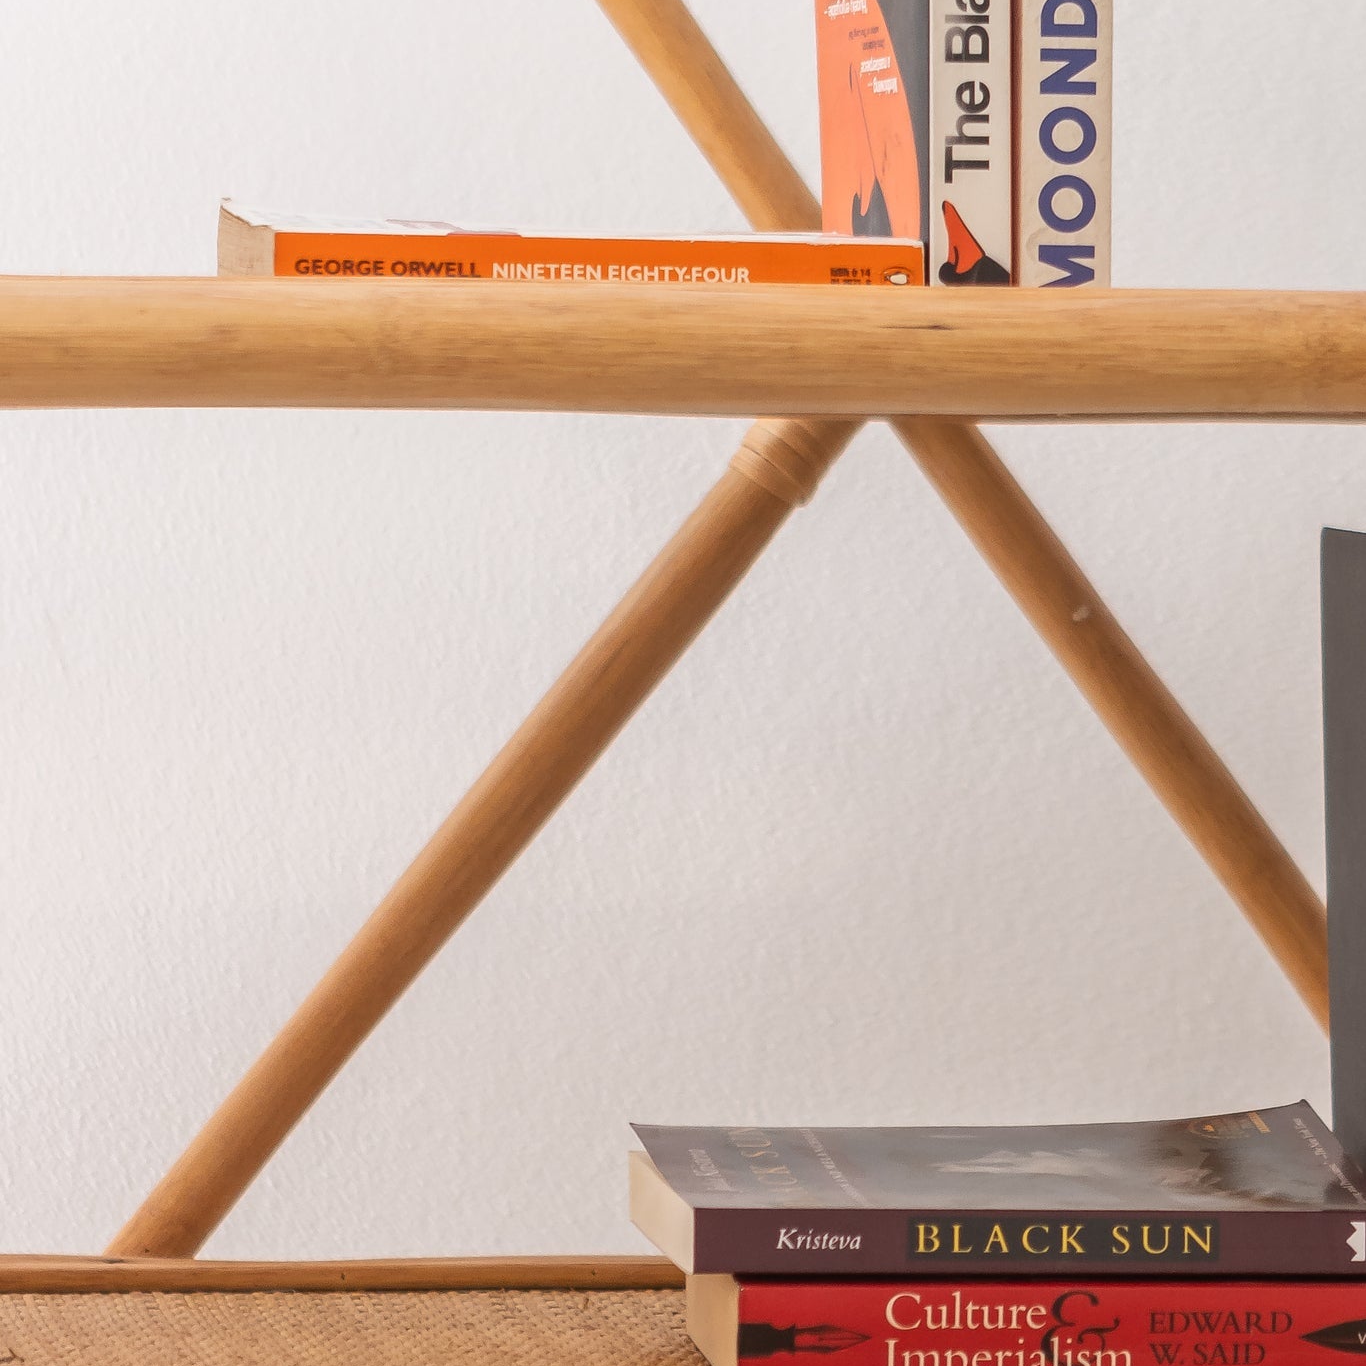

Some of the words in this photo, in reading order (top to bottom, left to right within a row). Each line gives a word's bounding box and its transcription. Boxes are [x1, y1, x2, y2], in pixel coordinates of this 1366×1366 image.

[944, 80, 990, 184] The
[294, 258, 385, 276] GEORGE
[390, 260, 481, 278] ORWELL
[492, 262, 601, 281] NINETEEN
[608, 265, 750, 284] EIGHTY-FOUR
[776, 1227, 862, 1251] Kristeva
[915, 1223, 1087, 1254] BLACK
[1111, 1223, 1212, 1255] SUN
[884, 1291, 1048, 1330] Culture
[1148, 1308, 1293, 1333] EDWARD
[1149, 1342, 1186, 1366] W.
[1193, 1342, 1266, 1366] SAID
